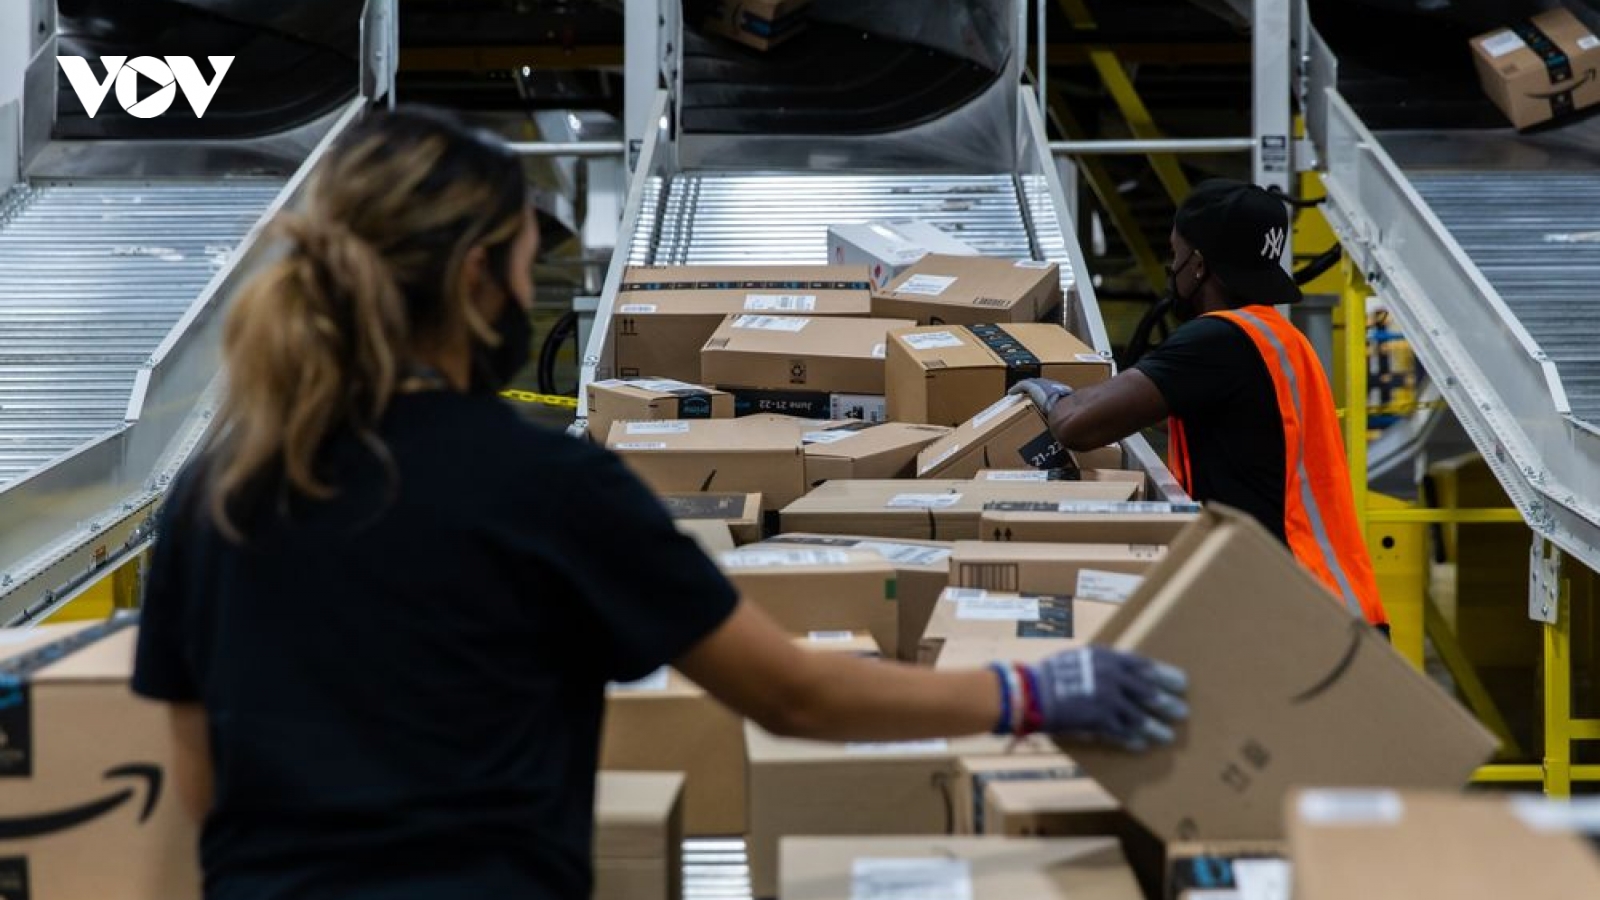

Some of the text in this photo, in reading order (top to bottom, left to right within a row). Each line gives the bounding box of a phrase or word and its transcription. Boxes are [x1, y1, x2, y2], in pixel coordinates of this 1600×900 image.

[1260, 226, 1284, 260] NY
[759, 399, 788, 409] 21-22
[789, 401, 813, 411] June
